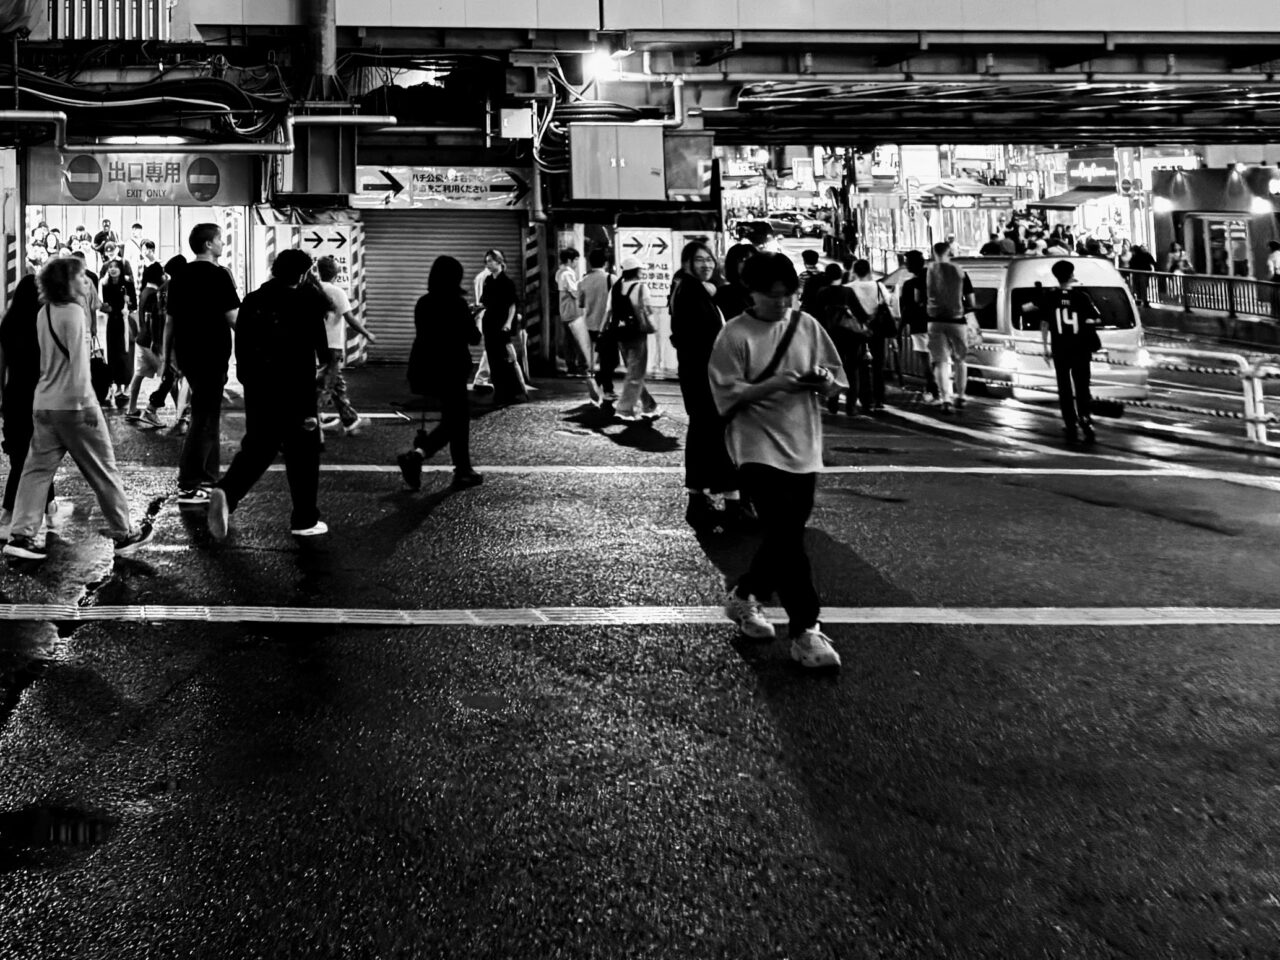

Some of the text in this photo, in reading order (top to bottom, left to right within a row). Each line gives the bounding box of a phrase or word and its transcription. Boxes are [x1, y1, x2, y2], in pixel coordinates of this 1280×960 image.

[108, 160, 181, 183] 出口専用
[126, 188, 168, 199] EXIT ONLY
[1055, 307, 1079, 334] 14
